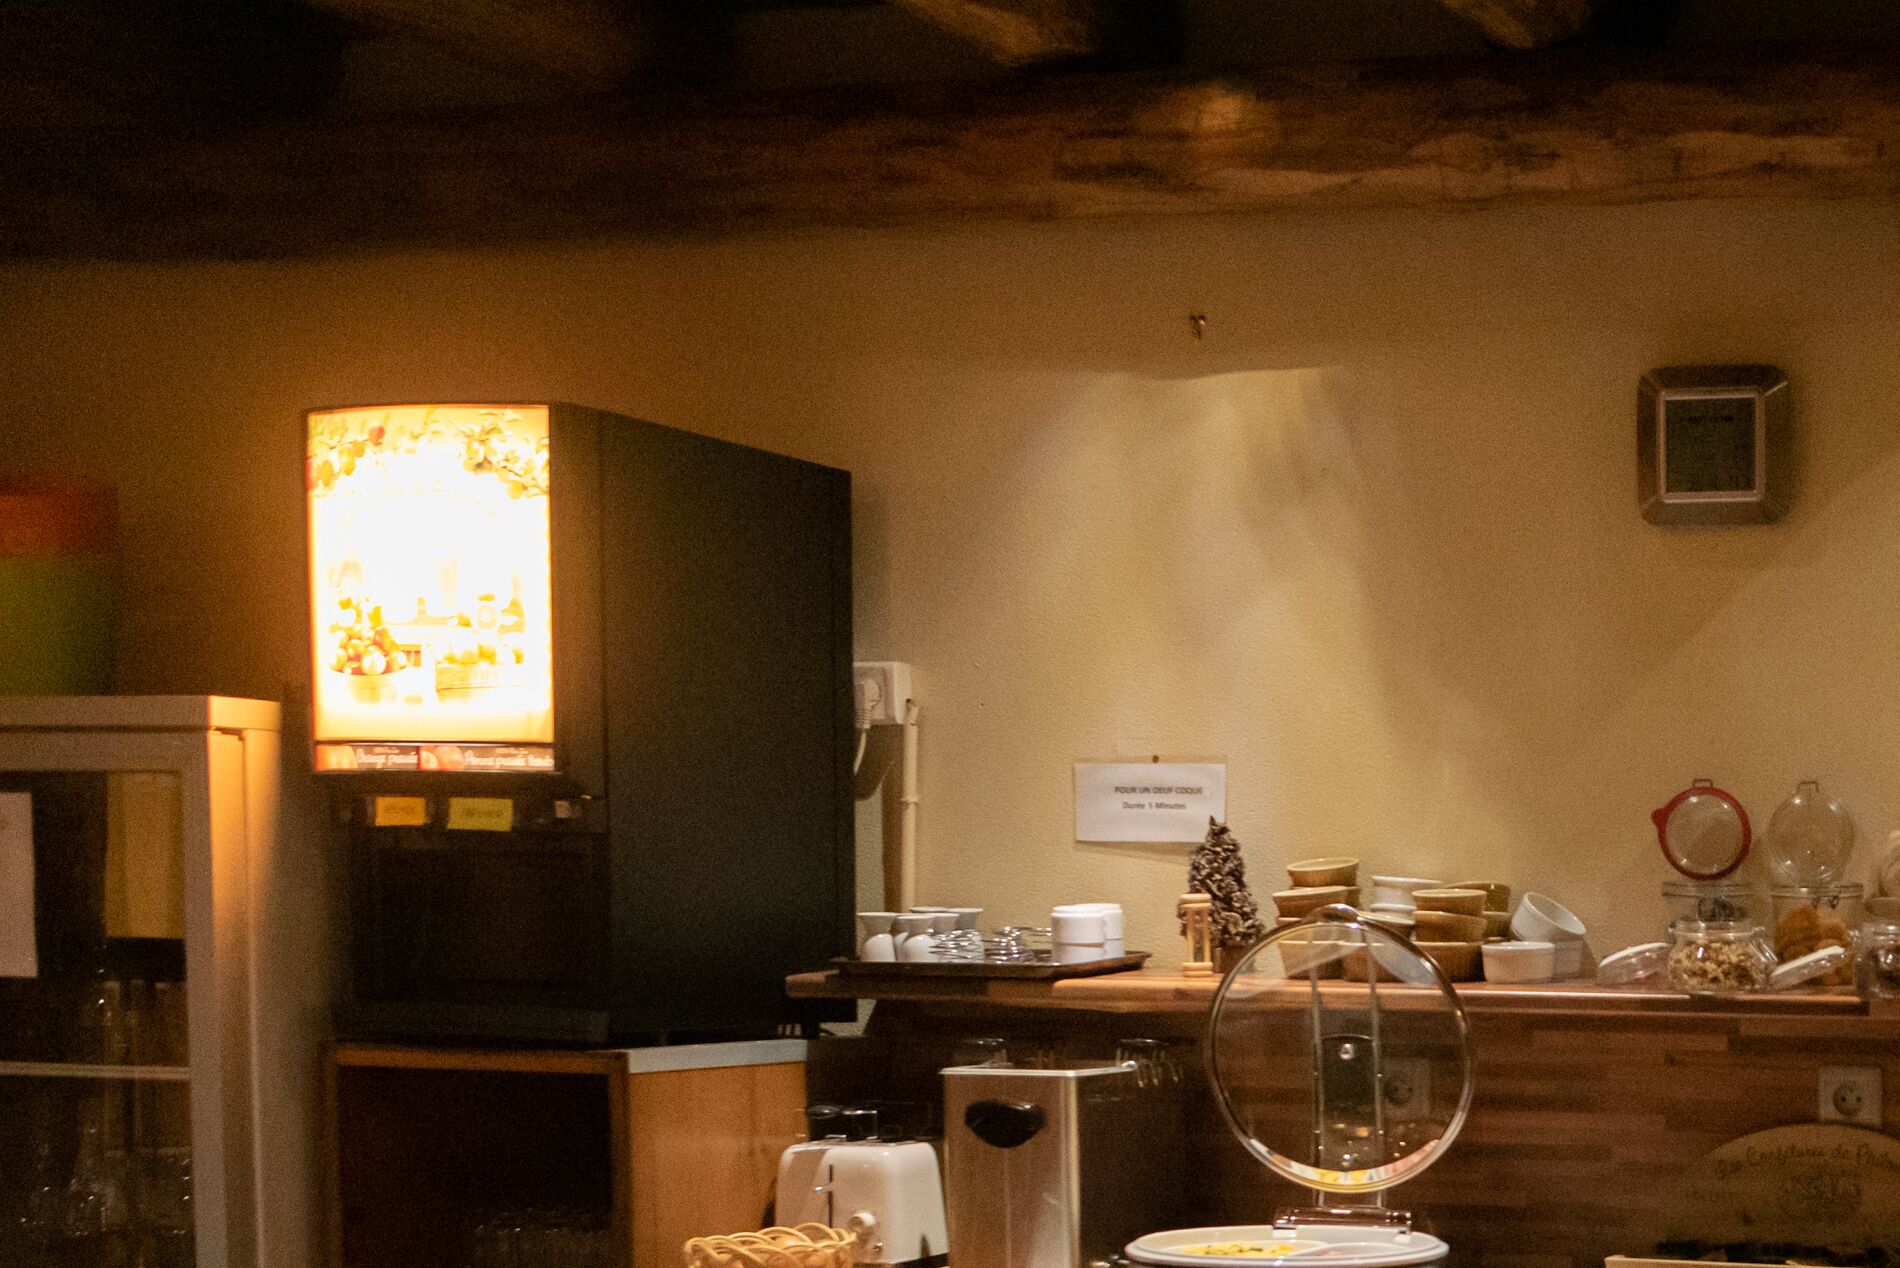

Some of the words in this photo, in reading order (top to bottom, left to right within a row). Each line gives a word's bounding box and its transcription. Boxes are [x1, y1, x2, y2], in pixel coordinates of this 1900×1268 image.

[1115, 786, 1137, 794] POUR
[1139, 786, 1151, 794] UN
[1175, 786, 1202, 795] COQUE
